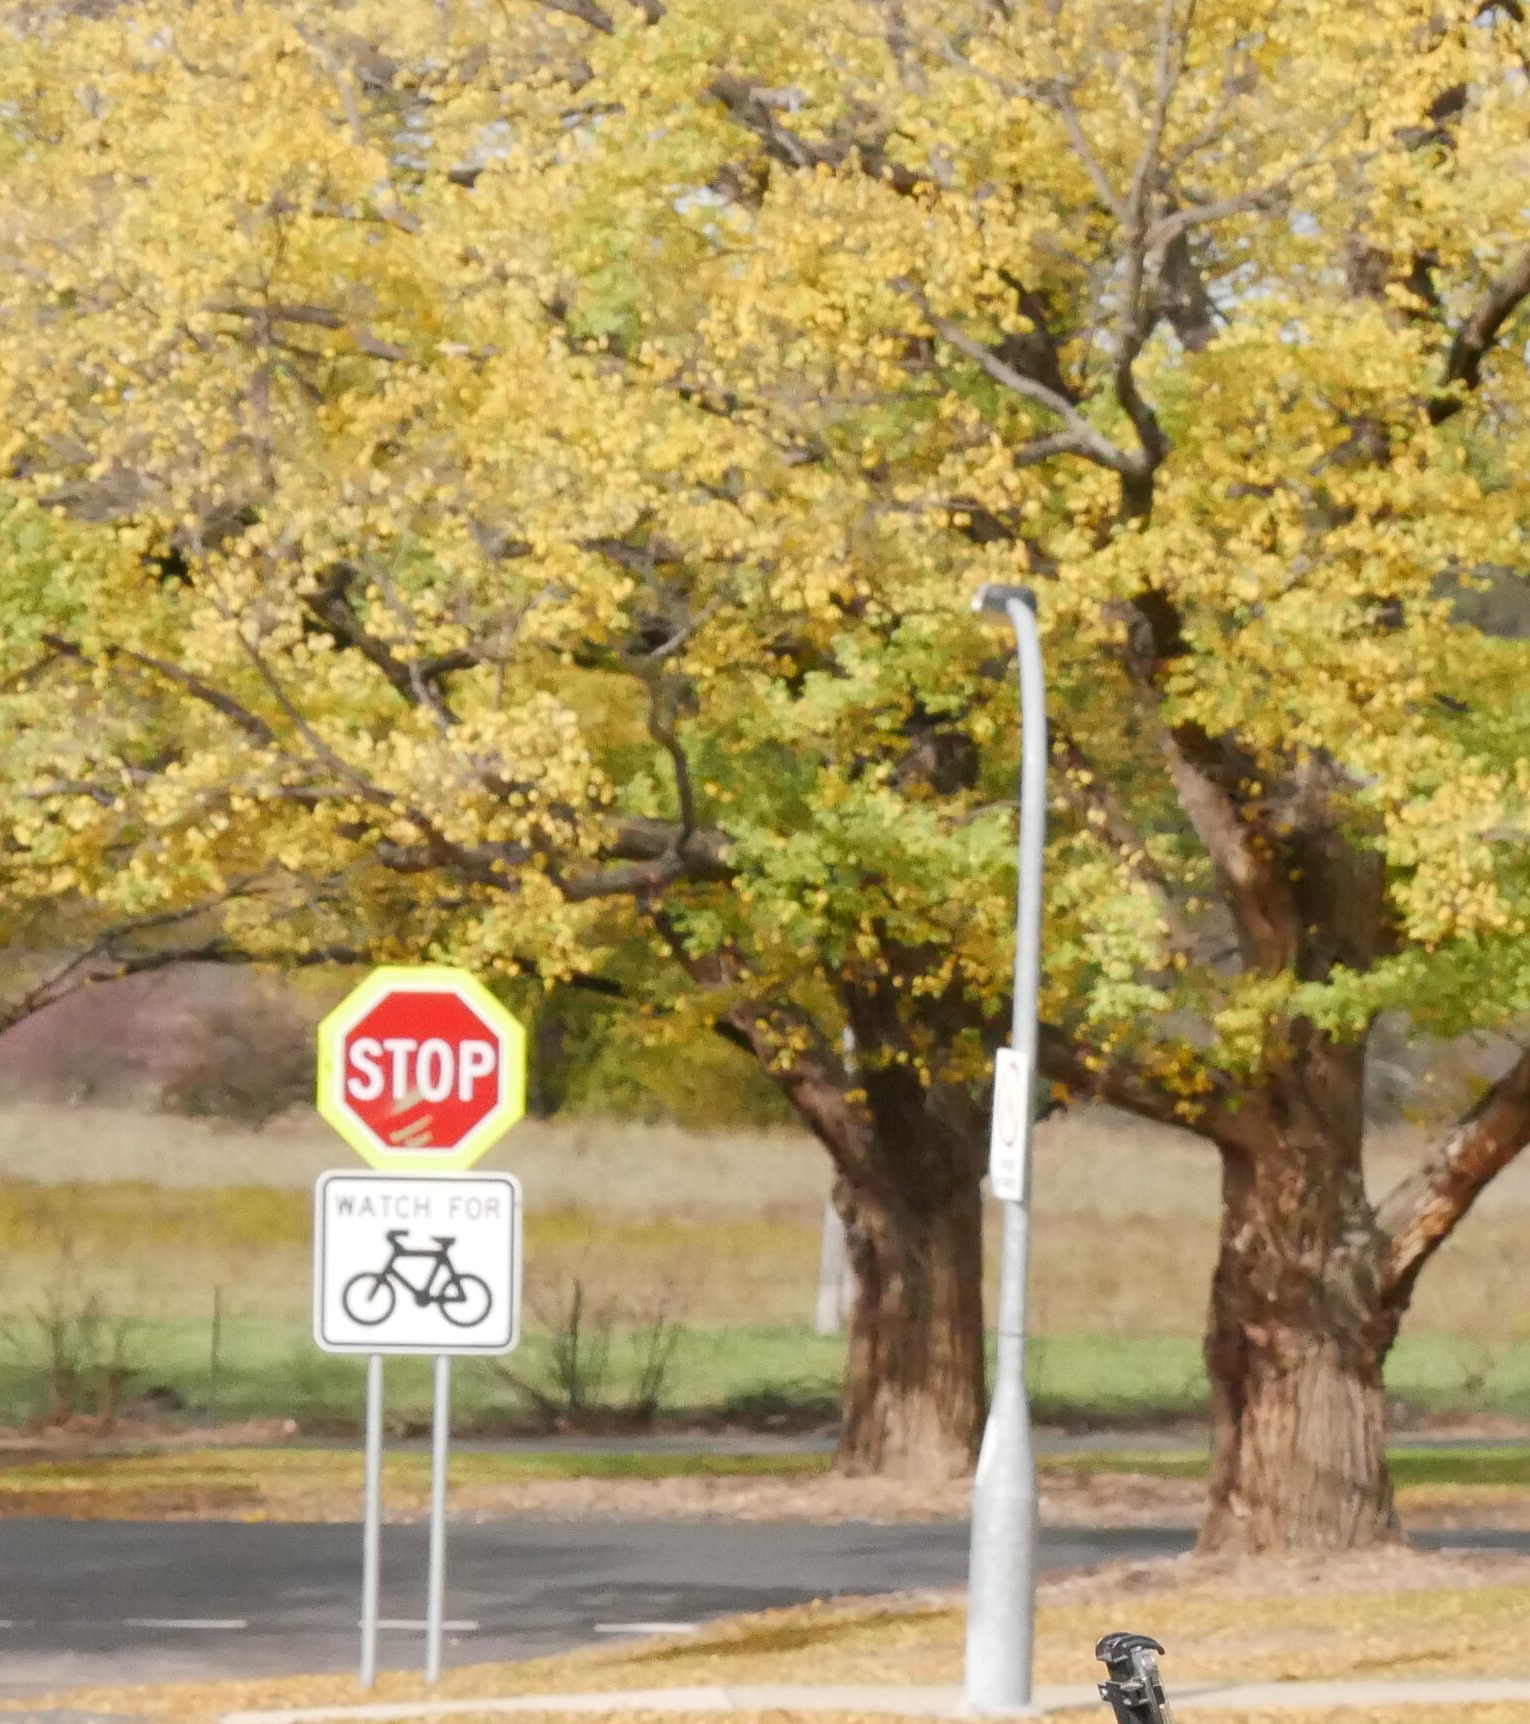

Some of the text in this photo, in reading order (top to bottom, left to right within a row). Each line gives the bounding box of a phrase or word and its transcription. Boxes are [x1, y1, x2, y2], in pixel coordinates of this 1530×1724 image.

[347, 1037, 496, 1103] STOP
[335, 1194, 501, 1220] WATCH FOR
